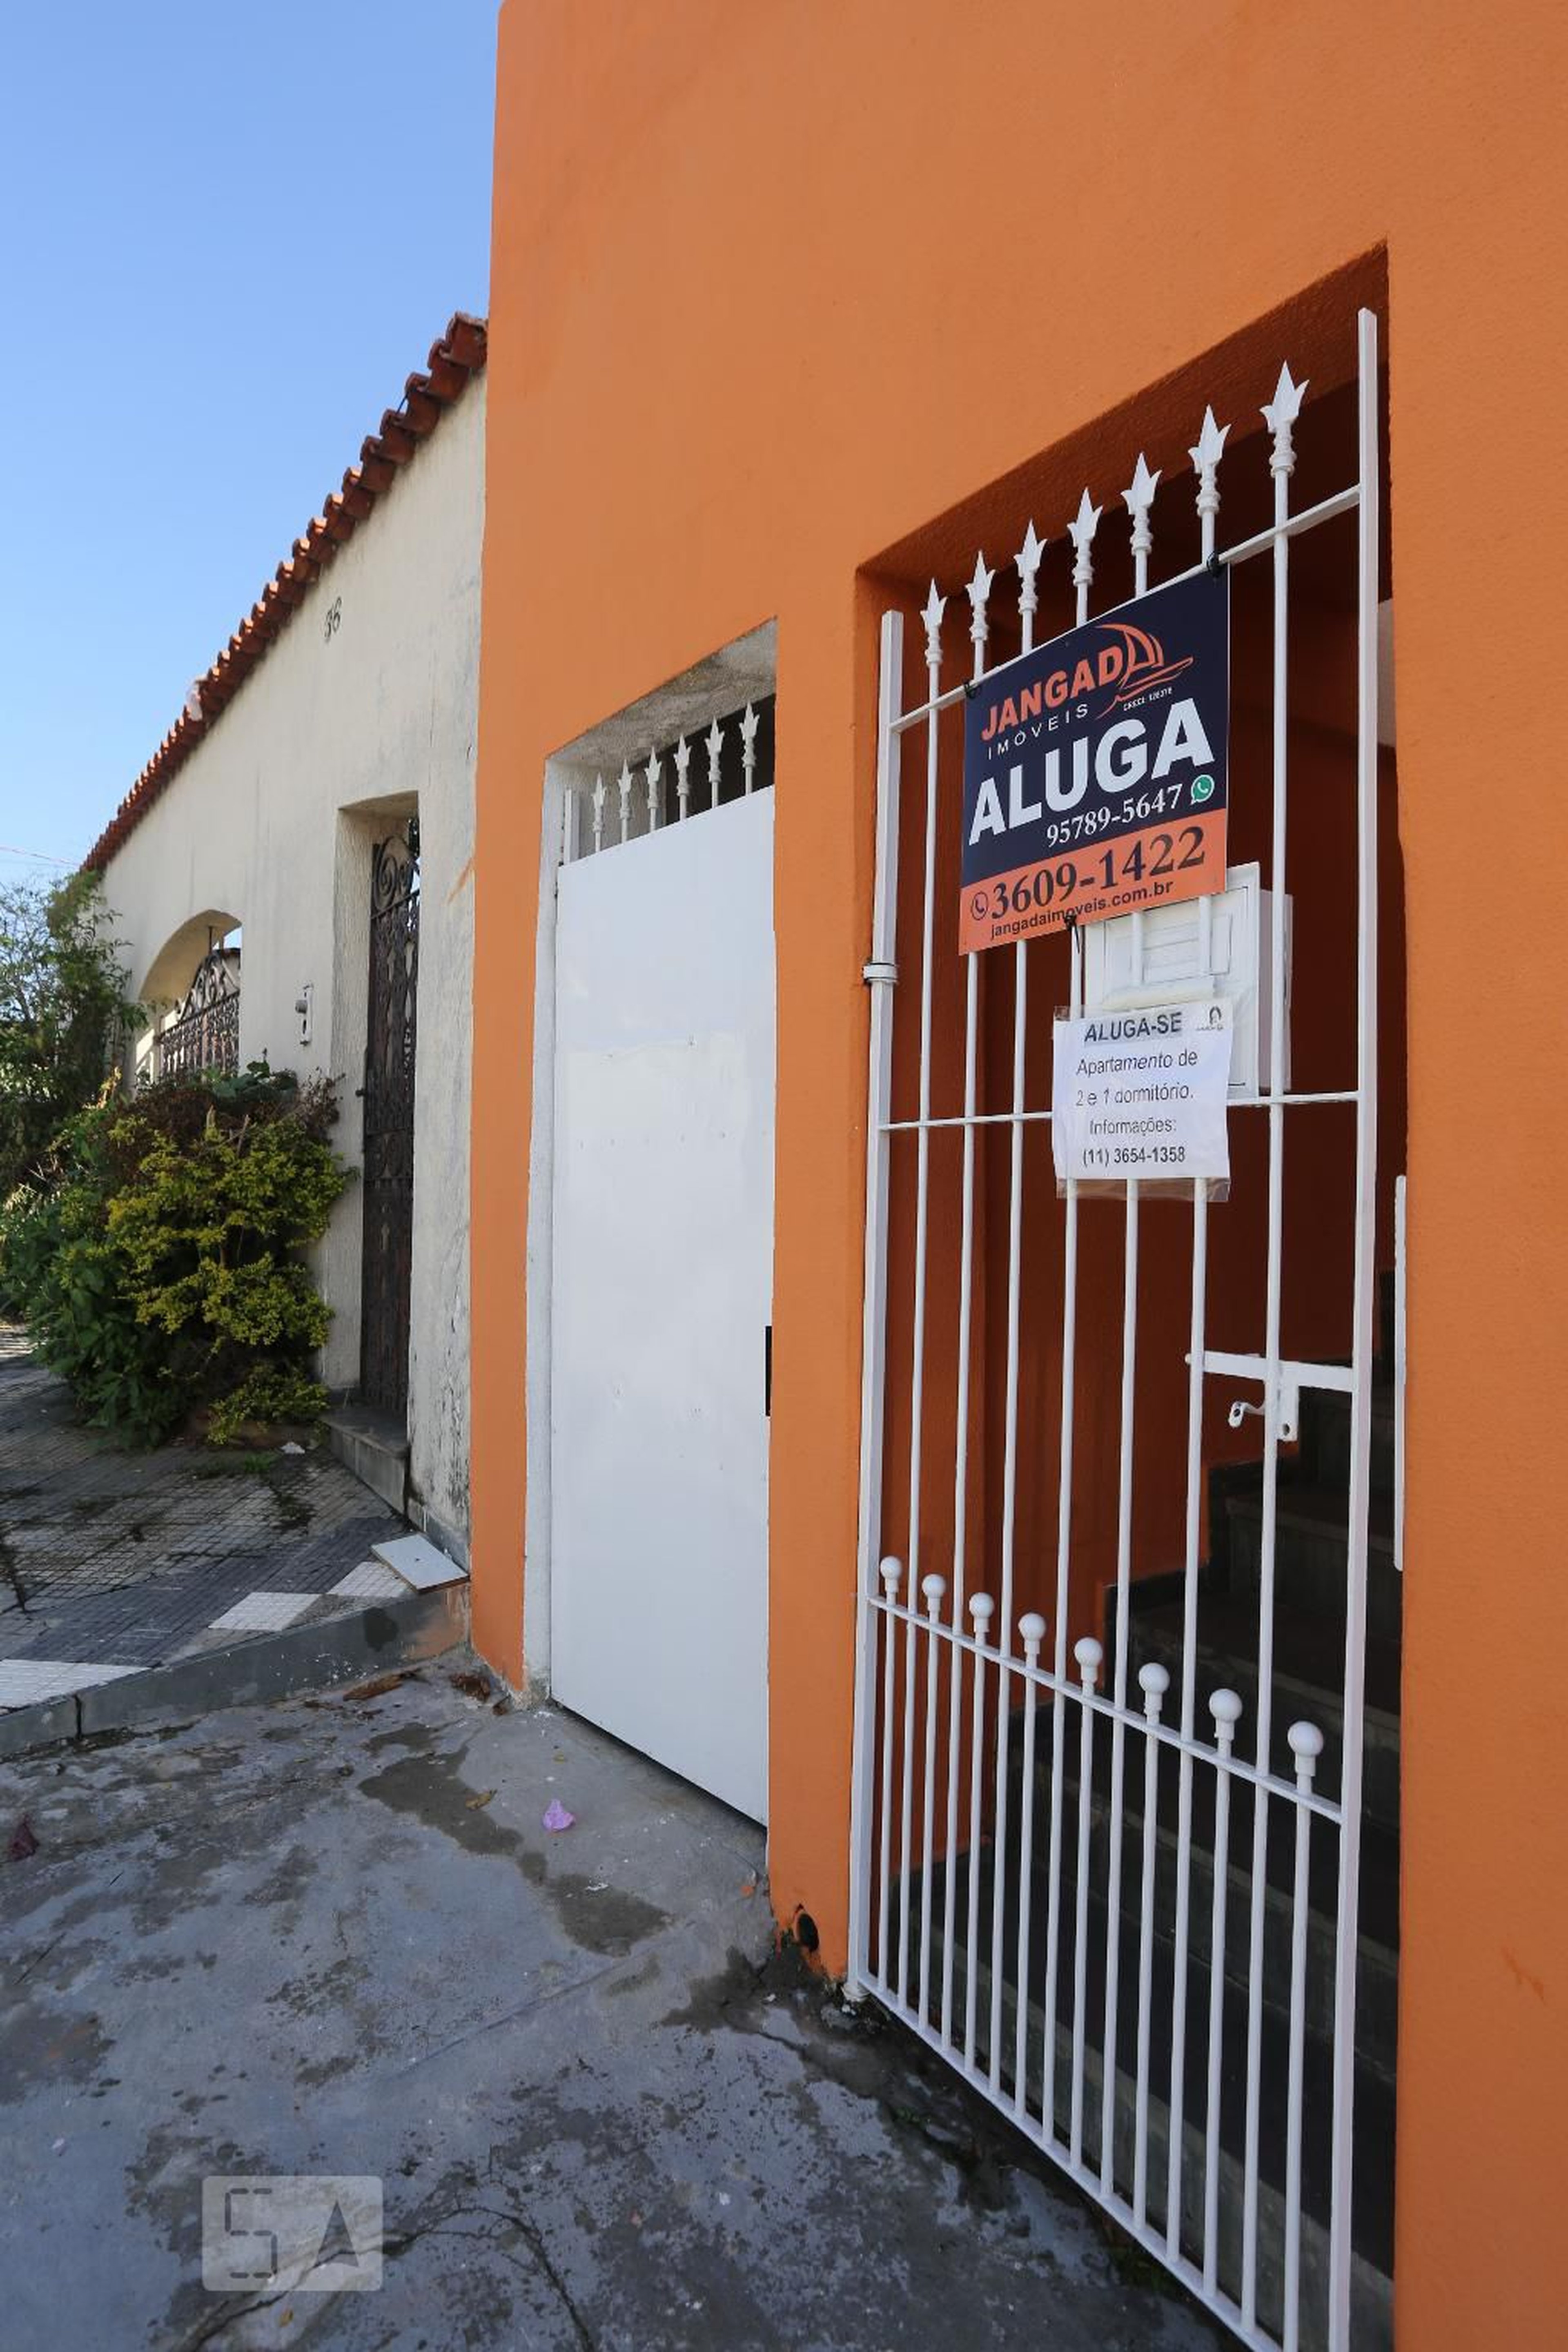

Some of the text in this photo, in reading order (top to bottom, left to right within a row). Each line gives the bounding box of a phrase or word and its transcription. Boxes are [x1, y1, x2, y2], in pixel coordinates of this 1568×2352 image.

[969, 697, 1215, 846] ALUGA
[1046, 783, 1183, 848] 95789-5647
[991, 826, 1205, 919] 3609-1422
[991, 880, 1174, 939] jangadaimoveis.com.br
[1084, 1012, 1183, 1042] ALUGA-SE
[1076, 1048, 1198, 1078] Apartamento de
[1076, 1089, 1084, 1106] 2
[1087, 1092, 1097, 1105] e
[1115, 1082, 1194, 1103] dormitório.
[1089, 1117, 1177, 1136] Informações:
[1083, 1146, 1186, 1168] (11) 3654-1358
